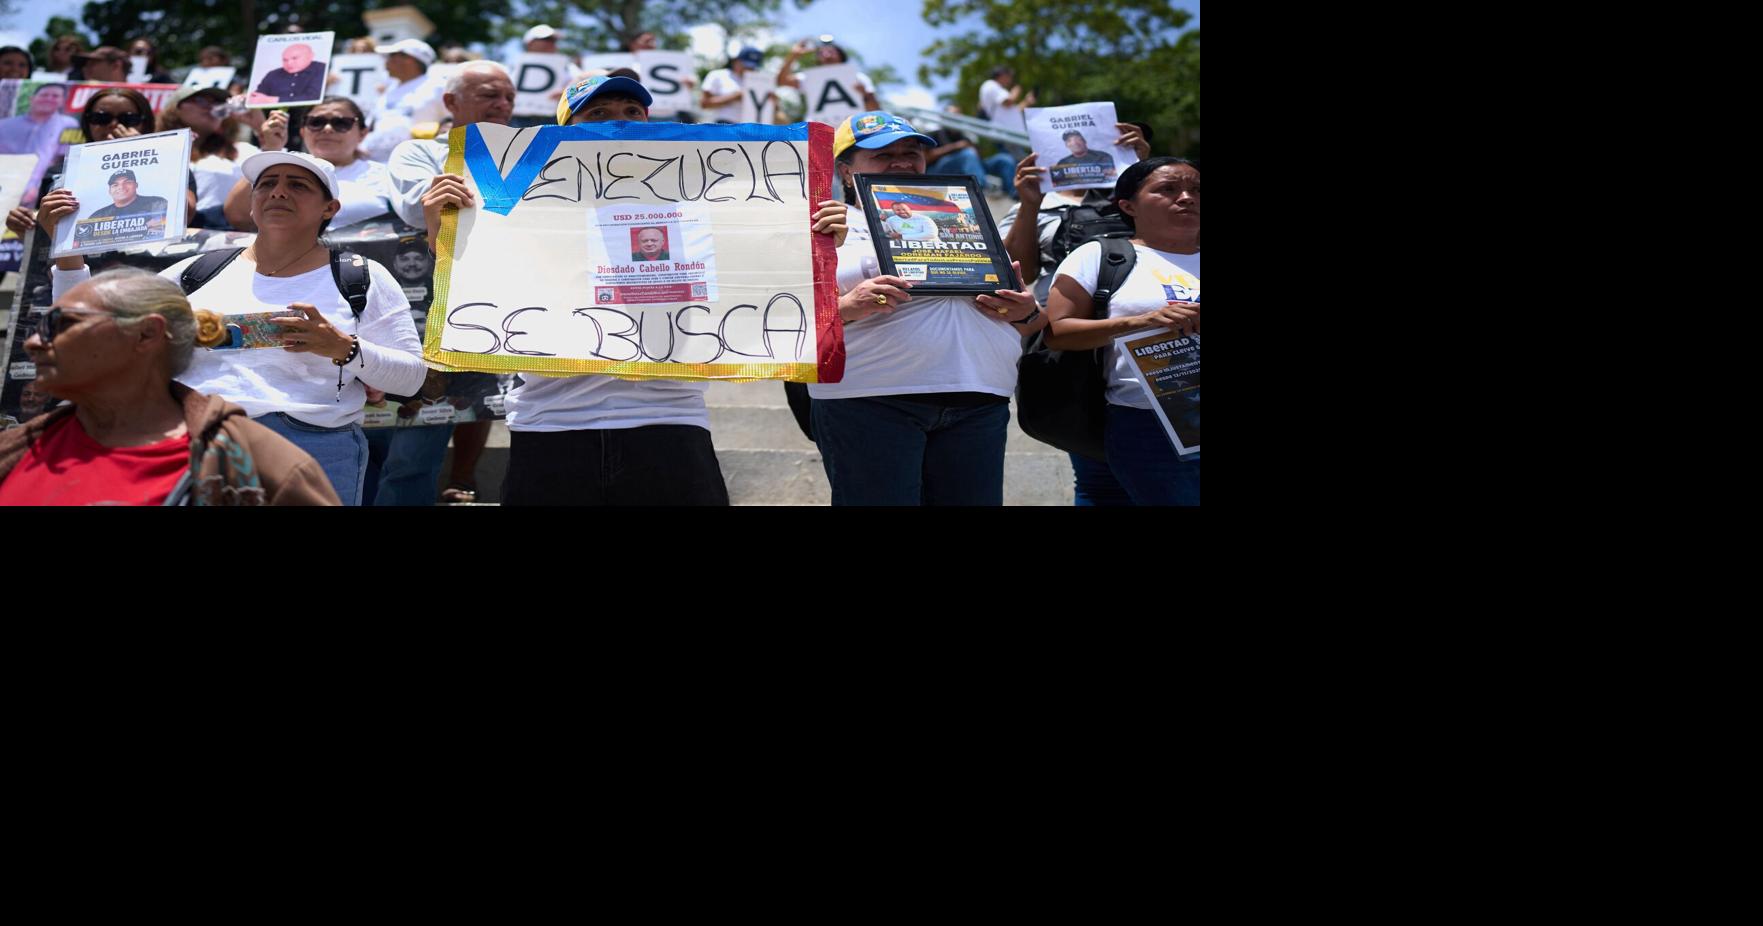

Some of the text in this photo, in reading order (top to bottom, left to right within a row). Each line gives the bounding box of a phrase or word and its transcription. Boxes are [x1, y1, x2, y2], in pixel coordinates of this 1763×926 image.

[342, 67, 376, 95] T
[516, 63, 556, 93] D
[650, 63, 682, 95] S
[815, 79, 858, 113] A
[750, 90, 771, 122] Y
[1050, 114, 1093, 122] GABRIEL
[1052, 121, 1096, 129] GUERRA
[102, 149, 159, 161] GABRIEL
[101, 157, 159, 170] GUERRA
[463, 122, 809, 217] VENEZUELA
[1063, 166, 1101, 174] LIBERTAD
[634, 211, 683, 221] 25.000.000
[94, 217, 145, 231] LIBERTAD
[889, 240, 987, 250] LIBERTAD
[597, 261, 706, 275] Diosdado Cabello Rondón
[440, 292, 807, 364] SE BUSCA
